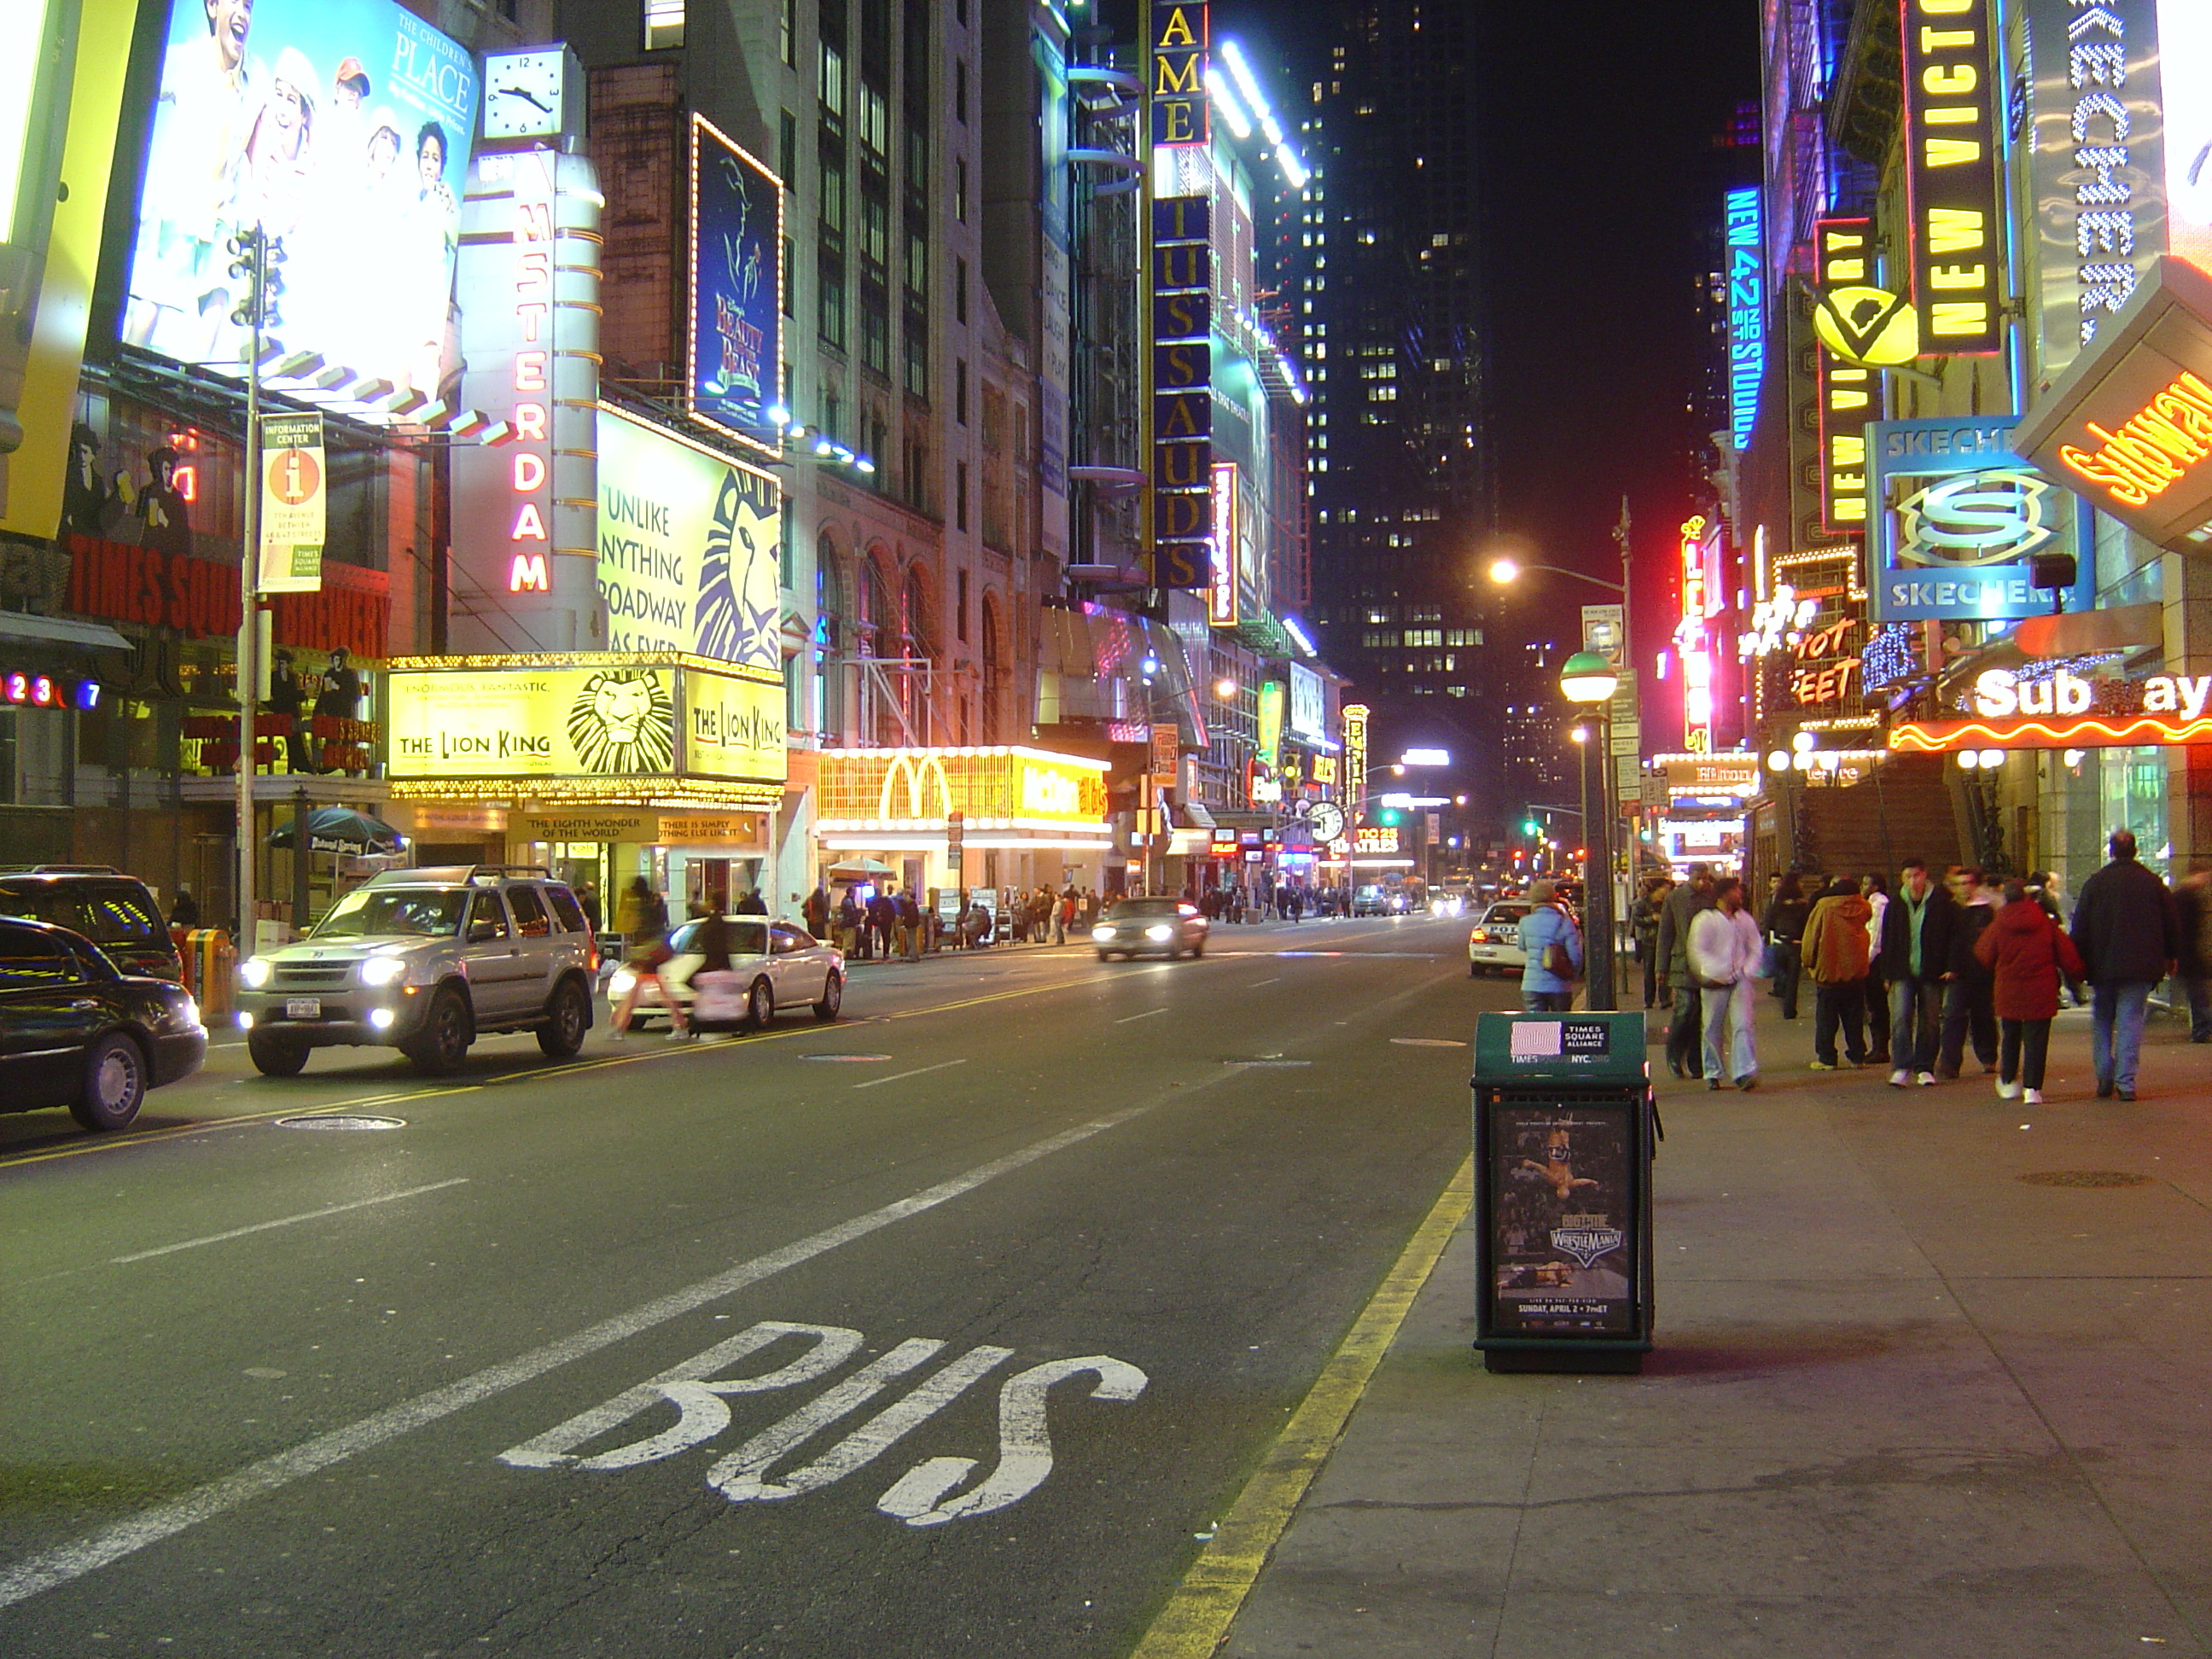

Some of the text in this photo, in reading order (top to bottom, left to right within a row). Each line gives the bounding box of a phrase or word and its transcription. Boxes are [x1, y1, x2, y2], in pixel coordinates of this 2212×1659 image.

[399, 13, 416, 35] THE
[392, 32, 470, 114] PLACE
[519, 57, 530, 68] 12
[1726, 190, 1760, 246] NEW
[1929, 207, 1987, 335] NEW
[716, 293, 764, 354] BEAUTY
[721, 335, 760, 381] BEAST
[265, 424, 320, 435] INFORMATION
[276, 434, 310, 445] CENTER
[1832, 436, 1866, 520] NEW
[295, 557, 319, 566] SQUARE
[597, 532, 684, 586] NYTHING
[70, 534, 164, 626] TIMES
[38, 678, 51, 702] 3
[88, 684, 101, 707] 7
[693, 701, 782, 751] THE LION KING
[400, 730, 551, 760] THE LION KING
[1697, 766, 1751, 782] Hilton
[542, 829, 555, 837] OF
[557, 829, 579, 837] THE
[594, 819, 640, 828] WONDER
[691, 829, 707, 837] ELSE
[701, 820, 731, 829] SIMPLY
[1518, 1304, 1549, 1314] SUNDAY,
[1549, 1304, 1572, 1313] APRIL
[1572, 1304, 1579, 1313] 2
[495, 1321, 1149, 1527] BUS
